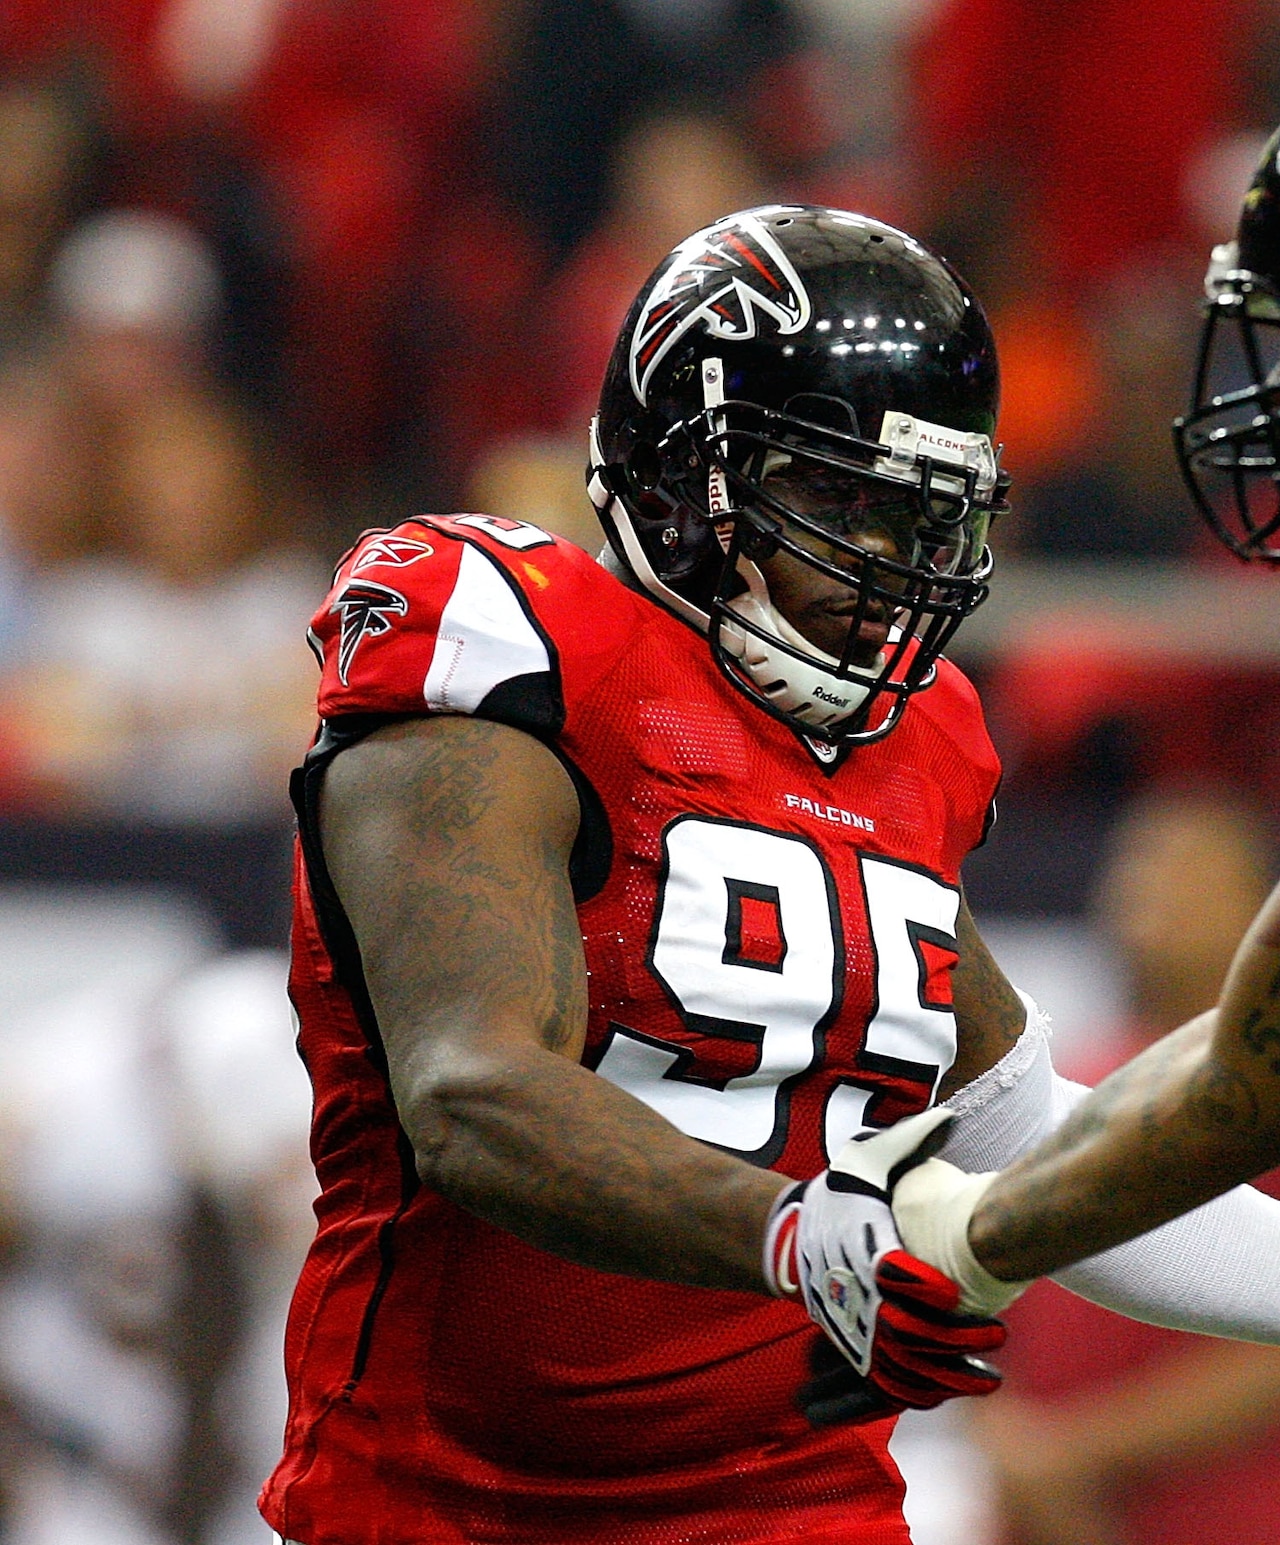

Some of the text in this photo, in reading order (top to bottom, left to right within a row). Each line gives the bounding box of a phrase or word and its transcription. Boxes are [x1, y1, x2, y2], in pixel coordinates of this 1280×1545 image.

[812, 686, 848, 708] Riddell
[784, 793, 875, 833] FALCONS
[595, 817, 960, 1166] 95
